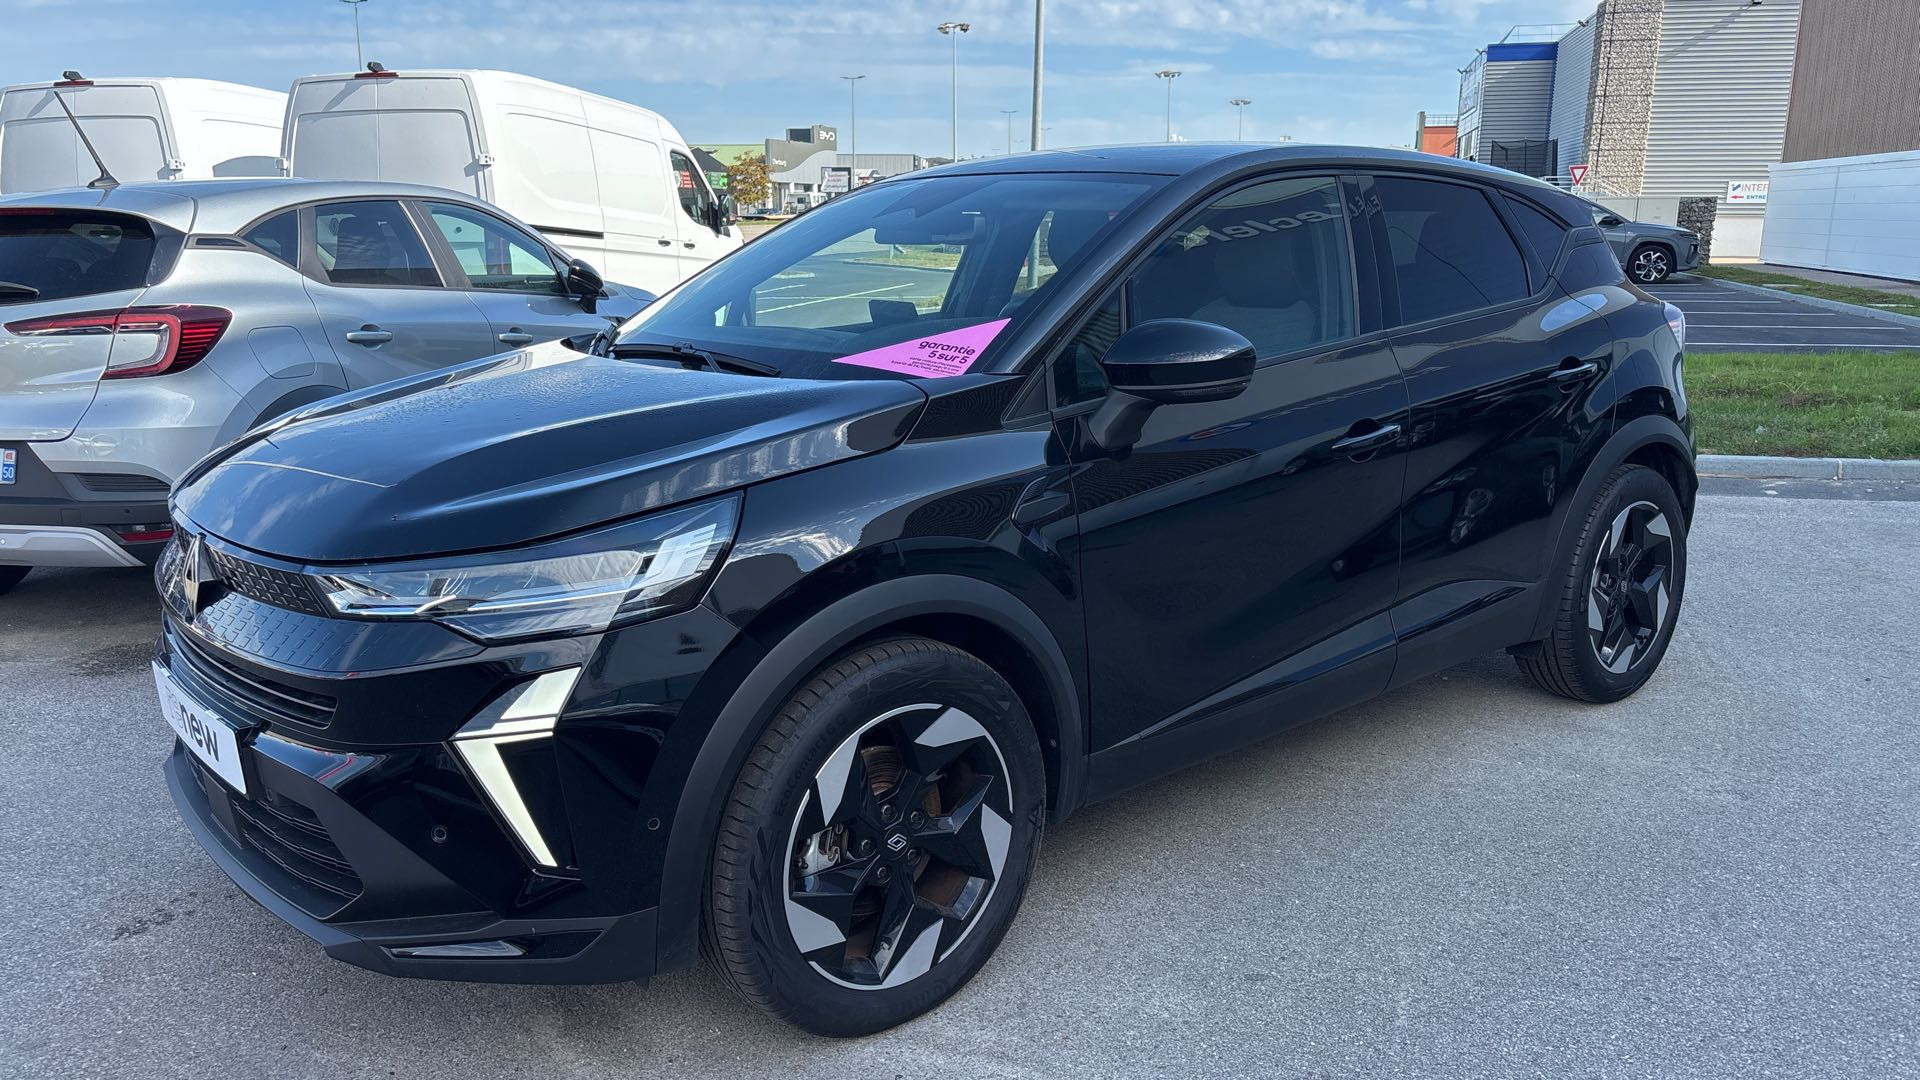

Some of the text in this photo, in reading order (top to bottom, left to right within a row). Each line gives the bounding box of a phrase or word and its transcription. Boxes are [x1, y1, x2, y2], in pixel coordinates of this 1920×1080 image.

[918, 341, 975, 355] garantie
[928, 350, 939, 359] 5
[937, 353, 959, 363] sur
[959, 355, 970, 364] 5
[3, 466, 14, 479] 50
